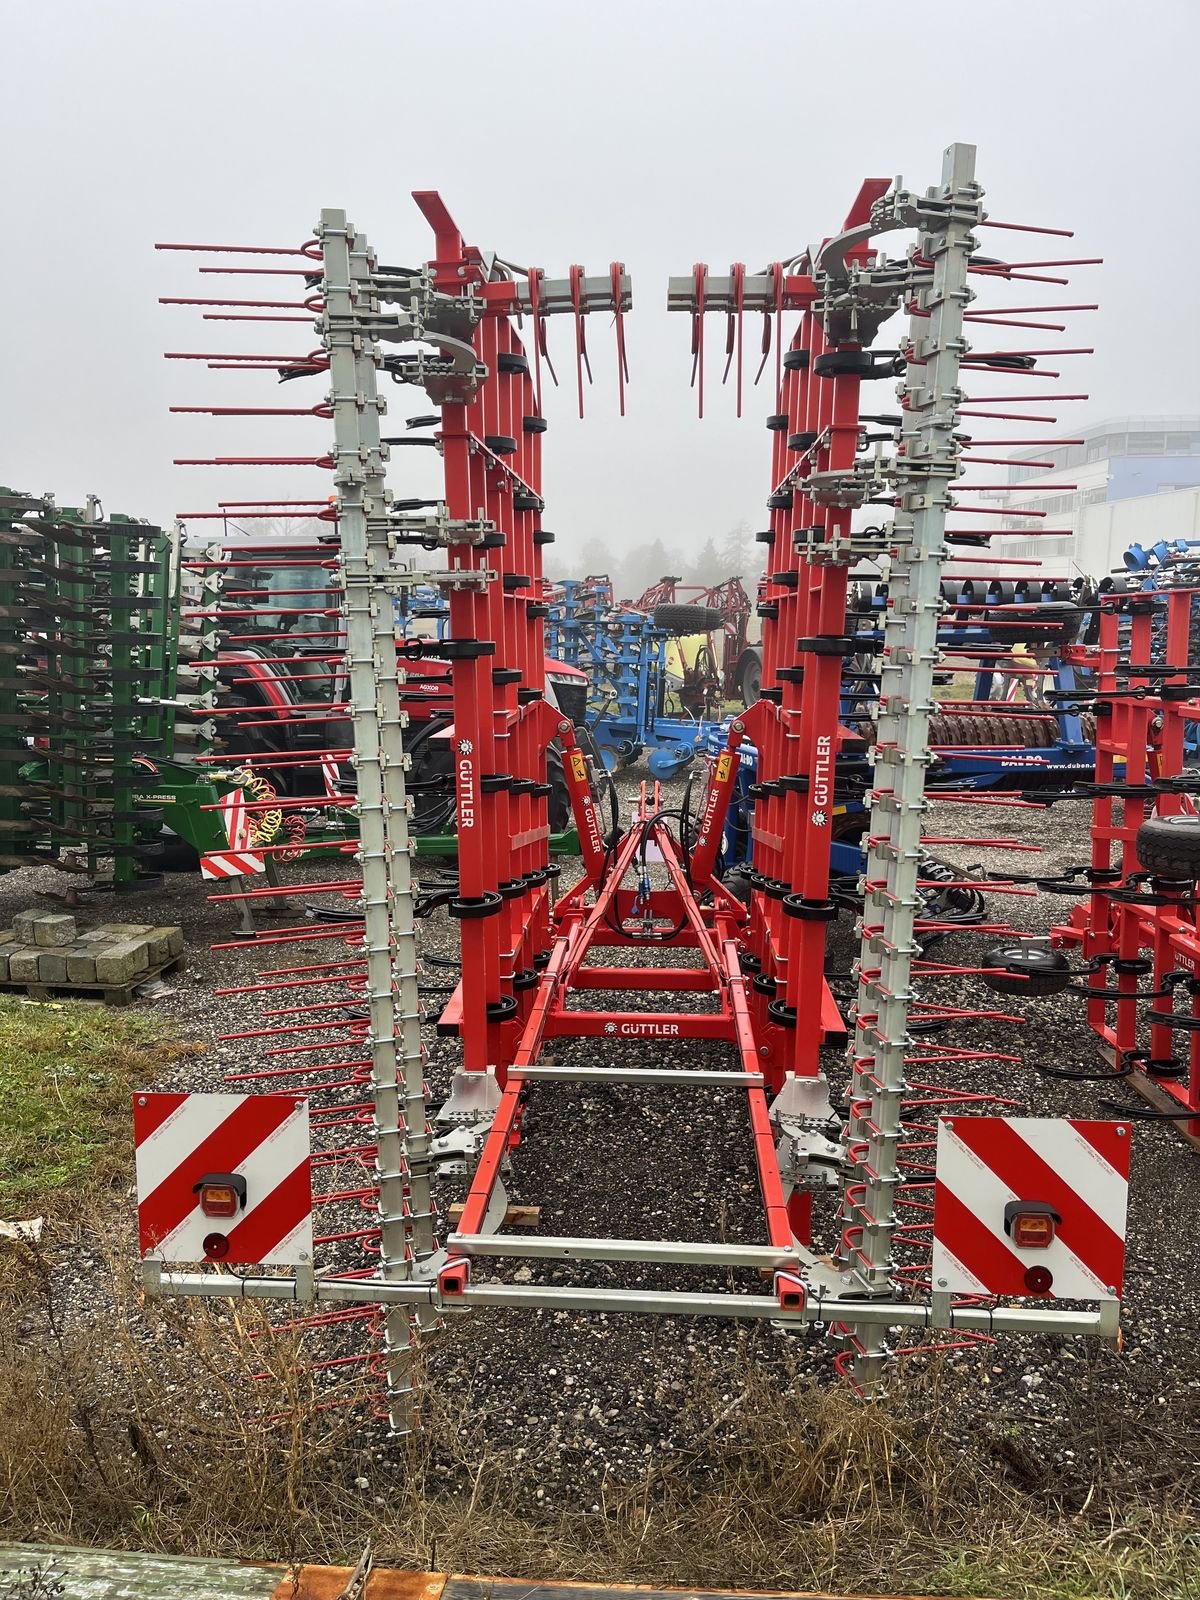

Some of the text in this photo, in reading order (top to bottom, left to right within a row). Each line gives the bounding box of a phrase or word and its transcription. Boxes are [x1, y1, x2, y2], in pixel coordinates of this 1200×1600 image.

[459, 759, 474, 828] GÜTTLER
[814, 735, 831, 806] GÜTTLER
[621, 1023, 679, 1035] GÜTTLER
